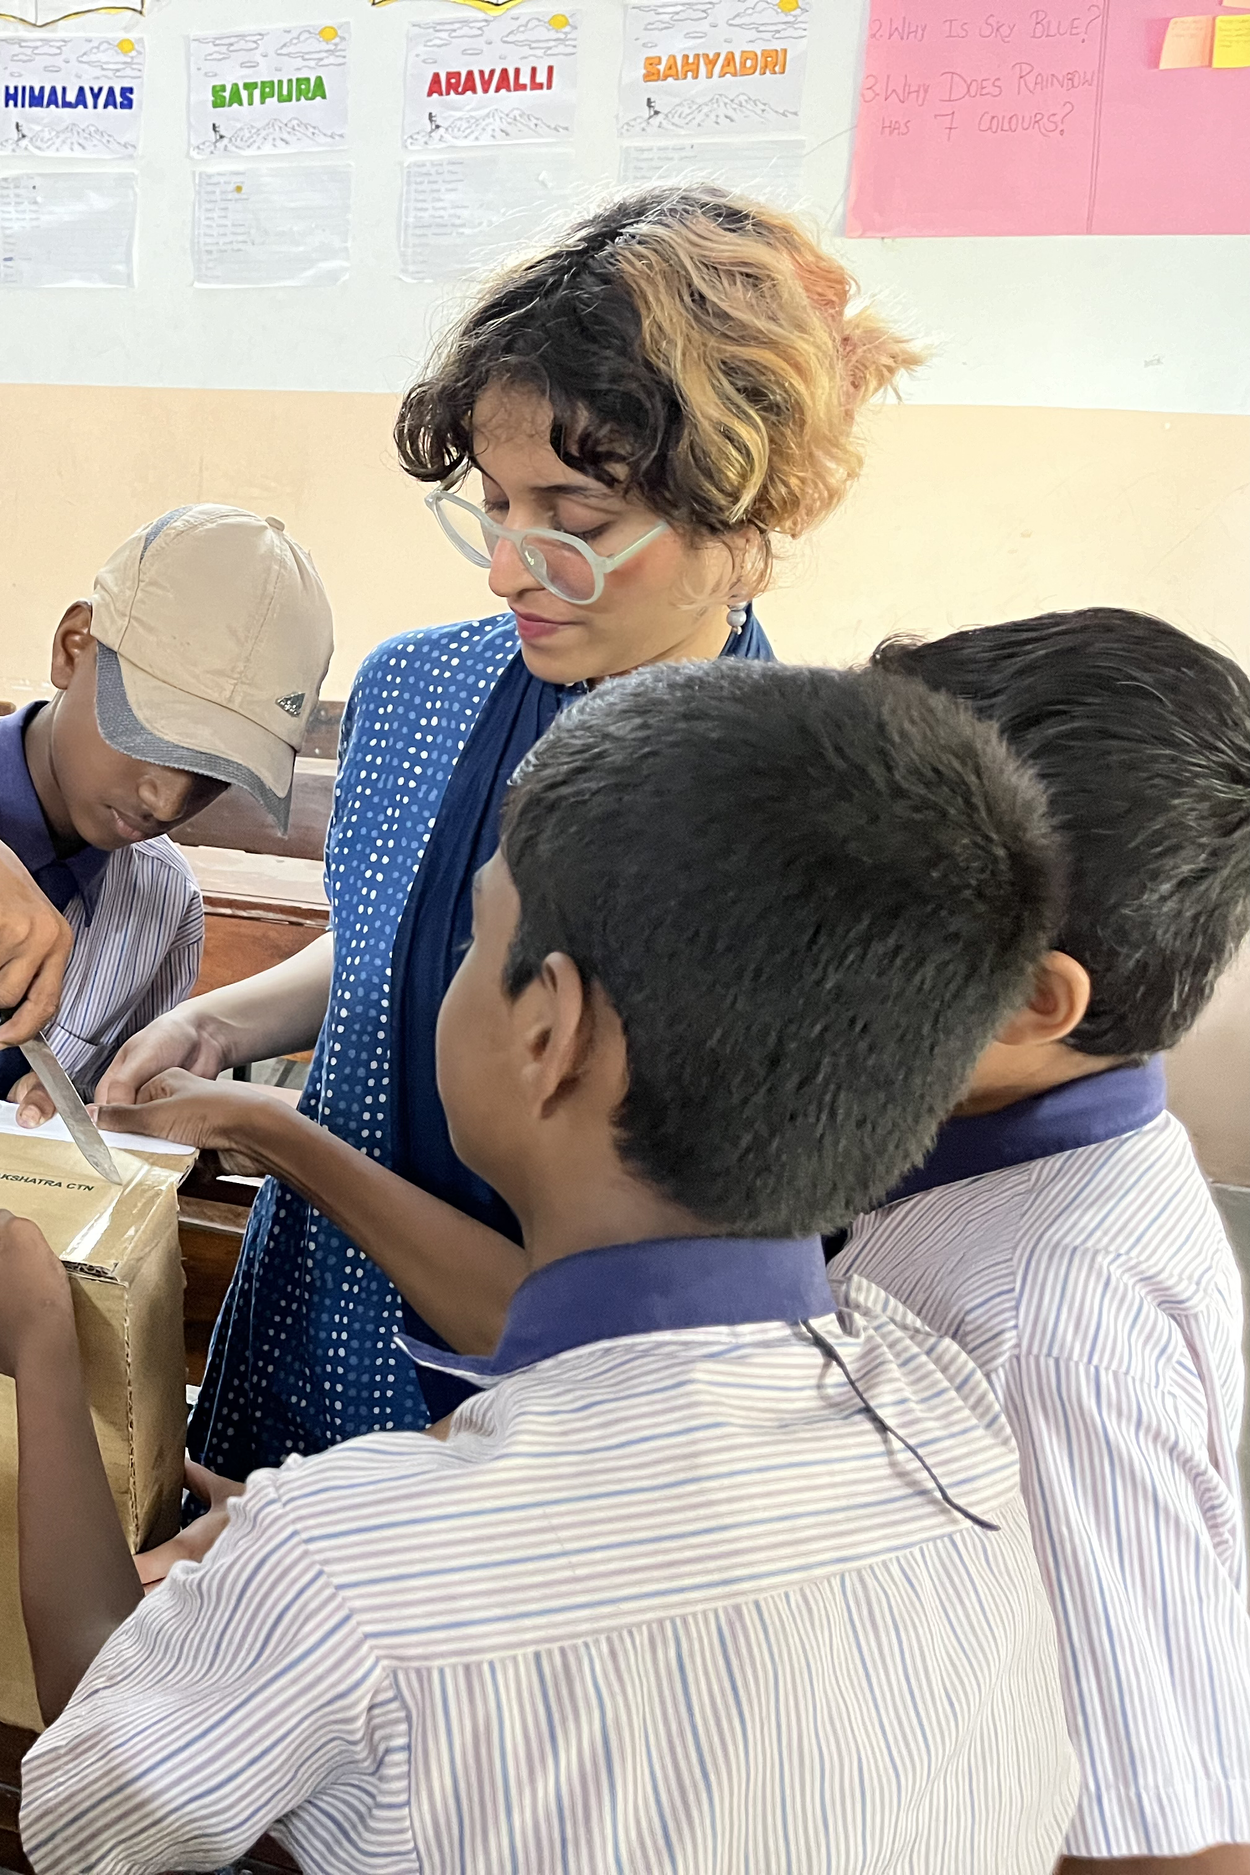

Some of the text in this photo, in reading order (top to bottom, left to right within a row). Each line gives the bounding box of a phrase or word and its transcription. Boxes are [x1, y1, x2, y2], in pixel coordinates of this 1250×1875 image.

[942, 18, 969, 39] IS
[978, 14, 1017, 43] SKY
[1029, 4, 1101, 43] BLUE?
[426, 65, 554, 97] ARAVALLI
[642, 48, 787, 82] SAHYADRI
[4, 85, 134, 110] HIMALAYAS
[211, 76, 327, 109] SATPURA
[938, 71, 1002, 102] DOES
[1011, 62, 1096, 95] RAINBOW
[880, 101, 1075, 141] HAS 7 COLOURS?
[66, 1181, 95, 1192] CTN
